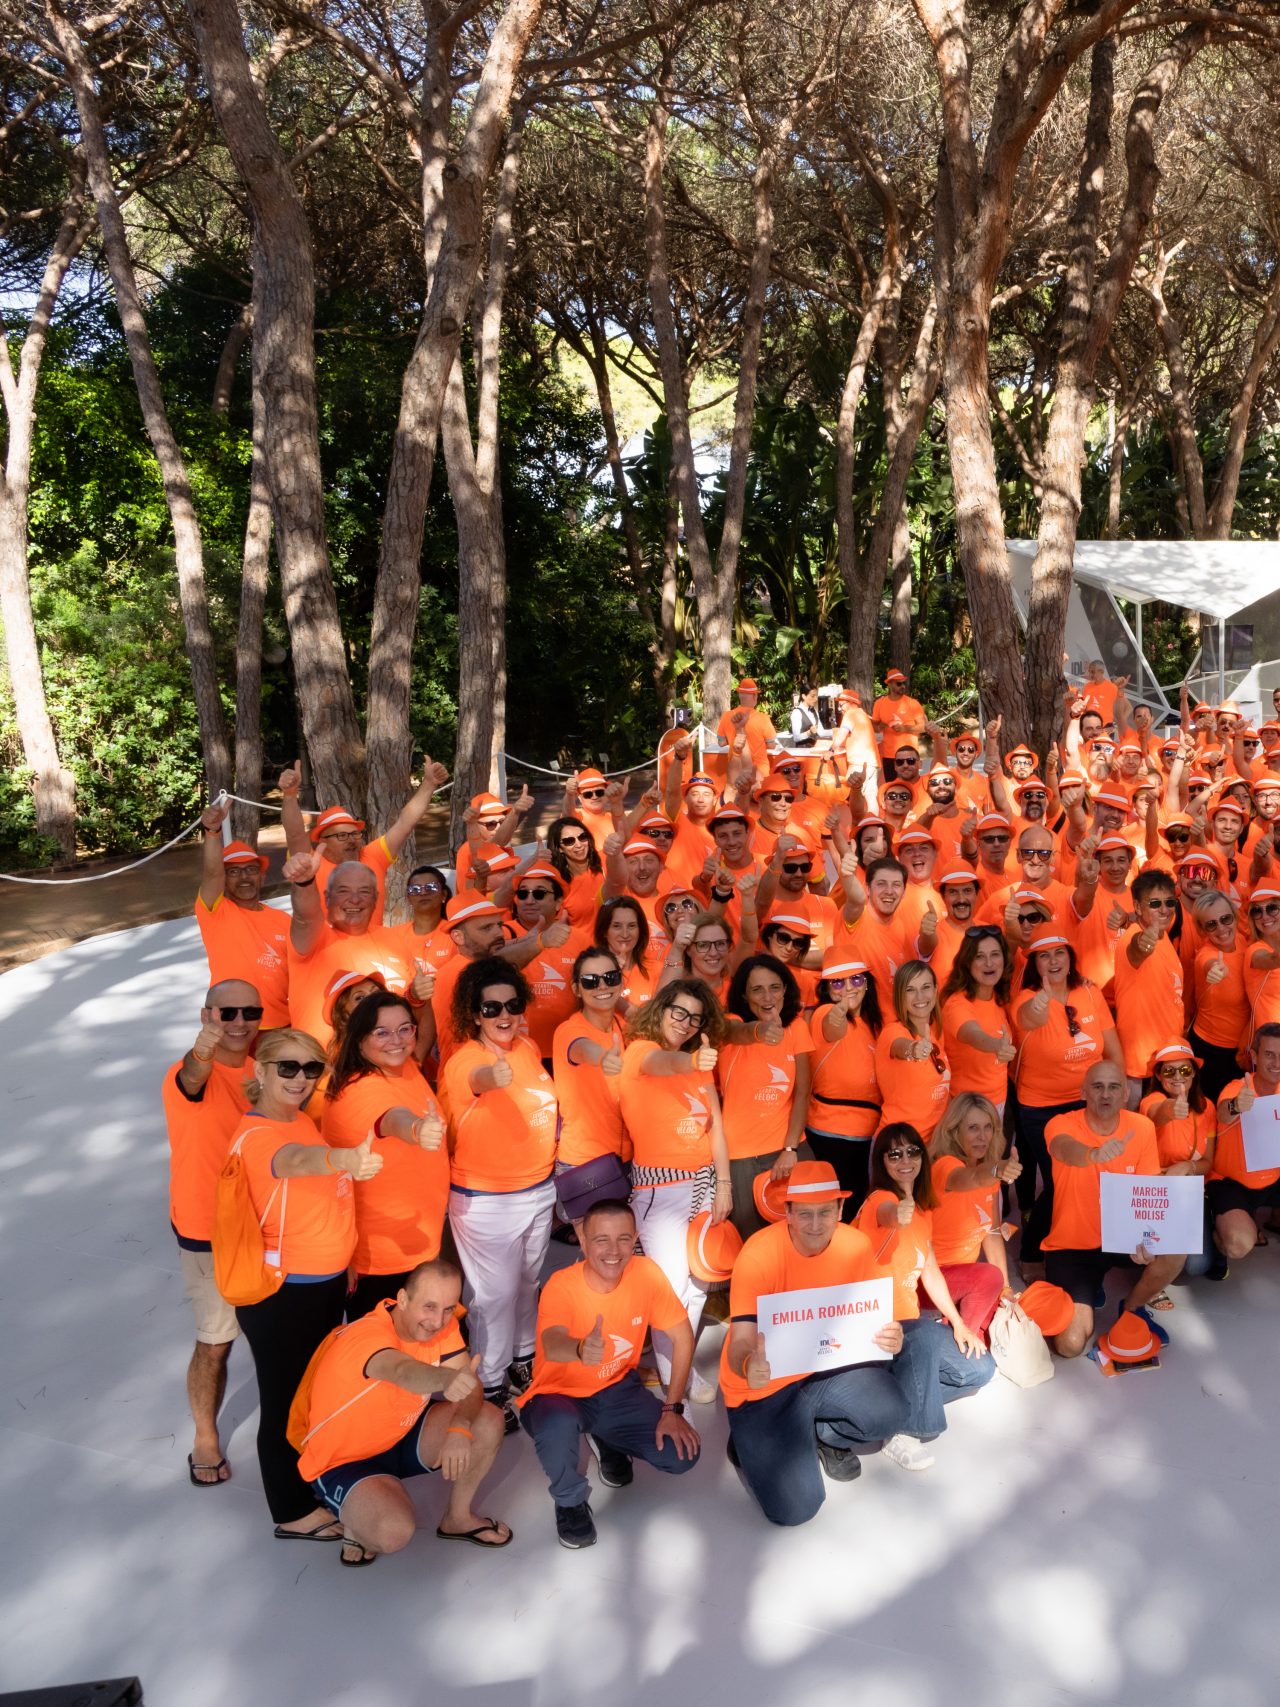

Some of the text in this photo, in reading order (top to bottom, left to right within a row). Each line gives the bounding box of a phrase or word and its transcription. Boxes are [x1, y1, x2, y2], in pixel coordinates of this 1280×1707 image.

[678, 709, 684, 722] 3
[1132, 1187, 1167, 1197] MARCHE
[1131, 1199, 1169, 1209] ABRUZZO
[1134, 1210, 1165, 1220] MOLISE
[772, 1299, 880, 1326] EMILIA ROMAGNA
